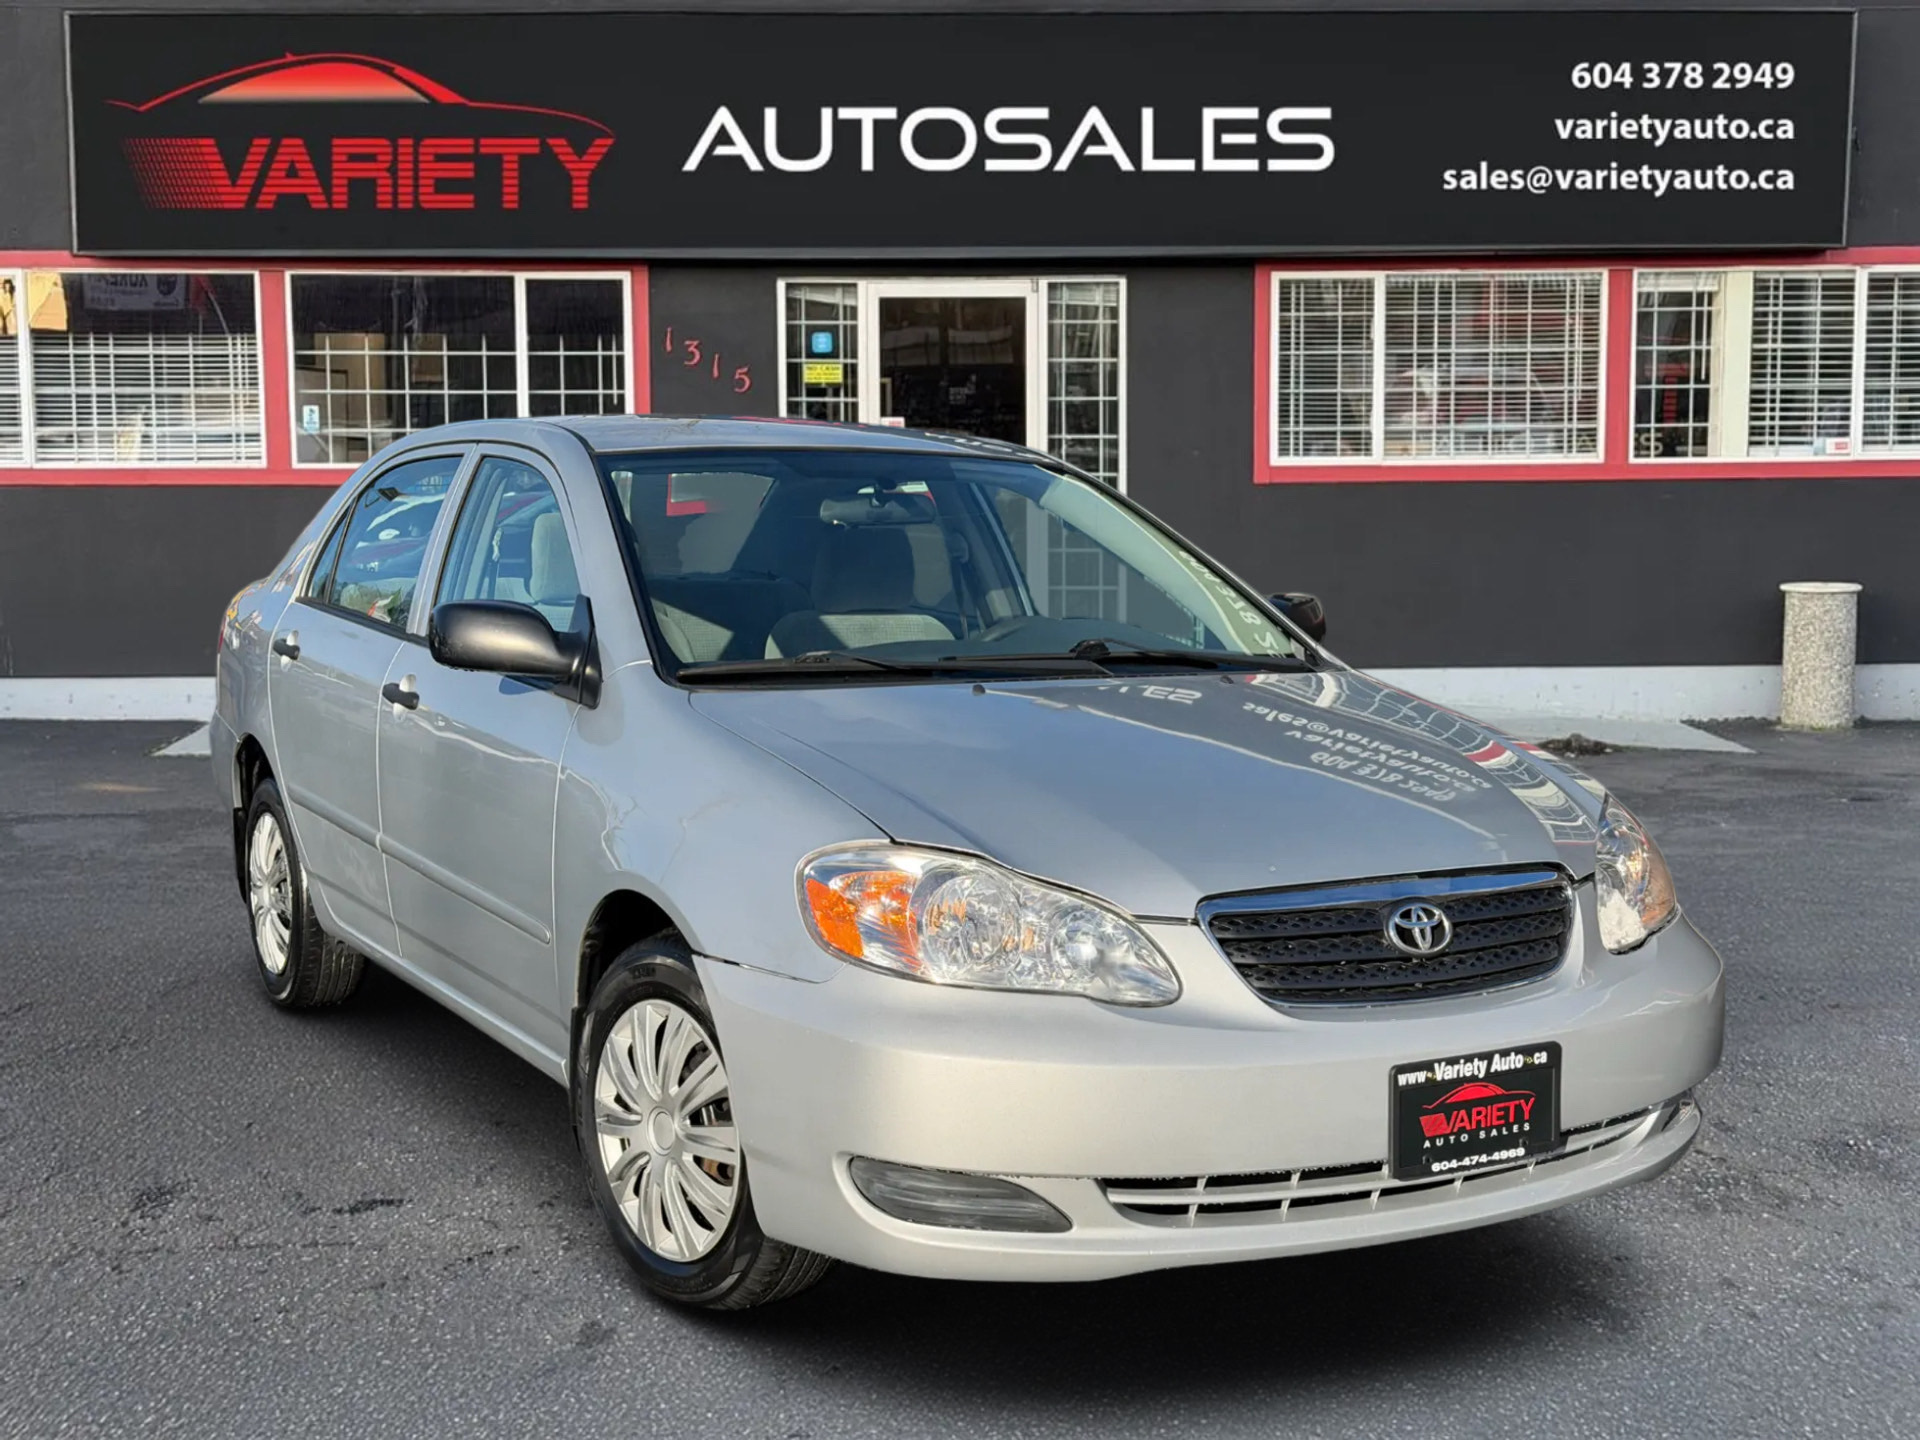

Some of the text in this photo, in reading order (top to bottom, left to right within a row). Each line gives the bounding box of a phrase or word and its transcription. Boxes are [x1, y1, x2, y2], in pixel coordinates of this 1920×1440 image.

[1571, 61, 1795, 90] 604 378 2949
[681, 105, 1335, 172] AUTOSALES
[1554, 111, 1795, 148] varietyauto.ca
[150, 137, 616, 211] VARIETY
[1443, 160, 1795, 198] sales@varietyauto.ca
[665, 326, 751, 393] 1315
[1419, 1097, 1536, 1137] VARIETY
[1423, 1122, 1531, 1149] AUTO SALES
[1431, 1147, 1526, 1172] 604-474-4969
